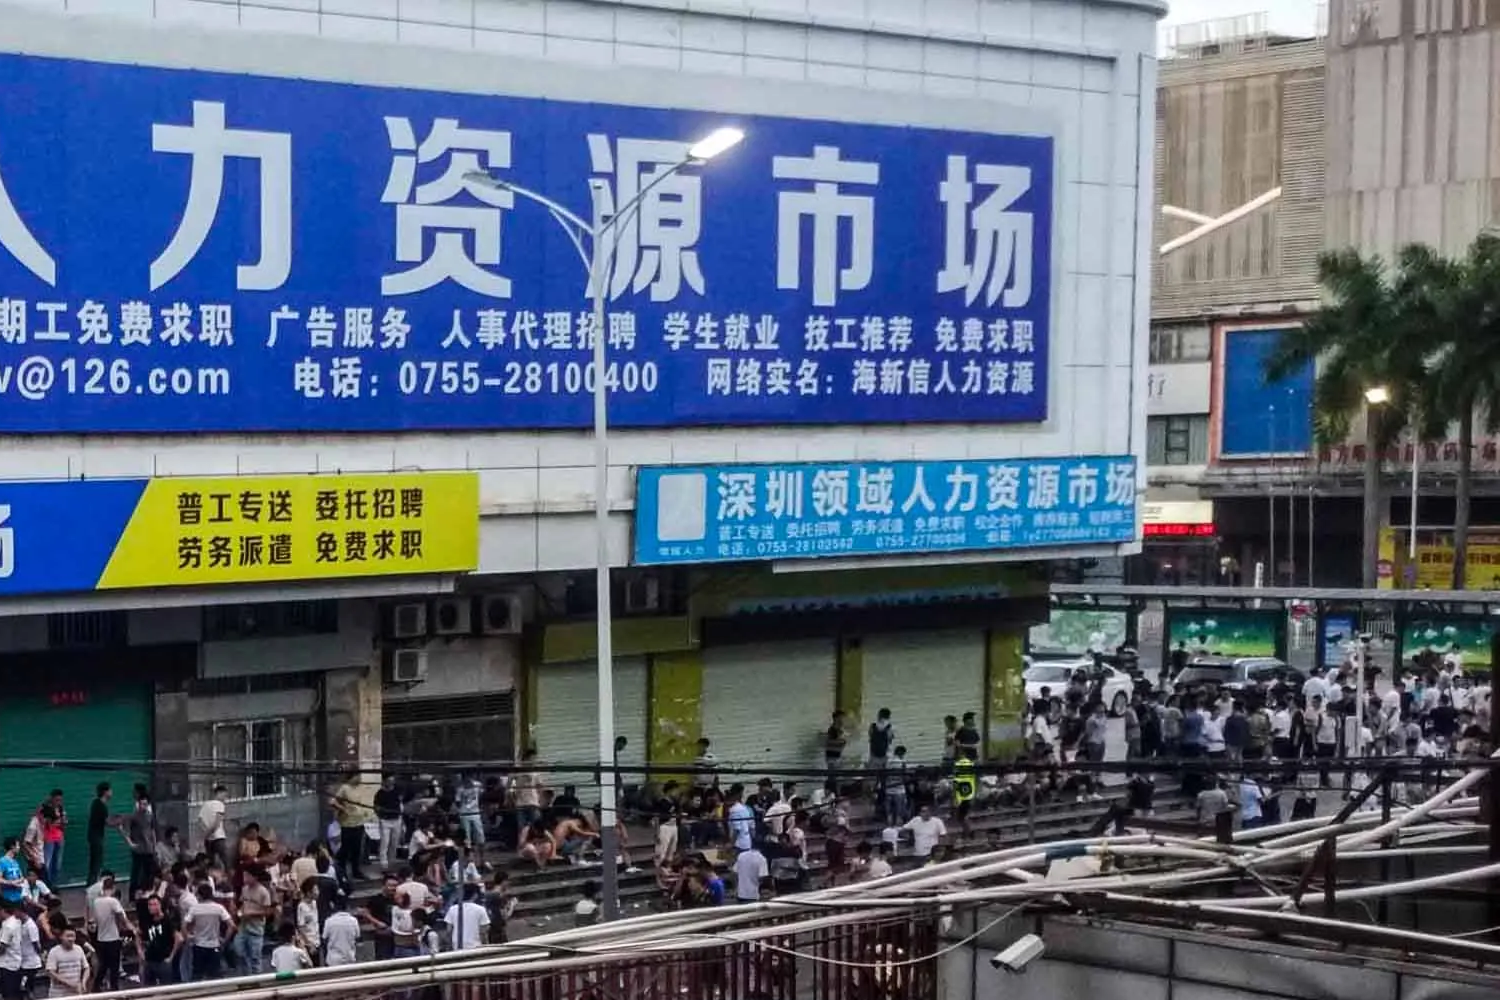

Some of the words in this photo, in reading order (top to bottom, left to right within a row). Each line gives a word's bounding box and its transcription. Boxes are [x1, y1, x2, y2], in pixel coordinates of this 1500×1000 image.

[266, 304, 411, 349] 广告服务
[663, 311, 780, 351] 学生就业
[804, 315, 913, 353] 技工推荐
[935, 317, 1034, 354] 免费求职
[177, 490, 293, 525] 普工专送
[315, 487, 424, 521] 委托招聘
[717, 462, 1135, 521] 深圳领域人力资源市场
[178, 533, 293, 569] 劳务派遣
[315, 529, 423, 563] 免费求职
